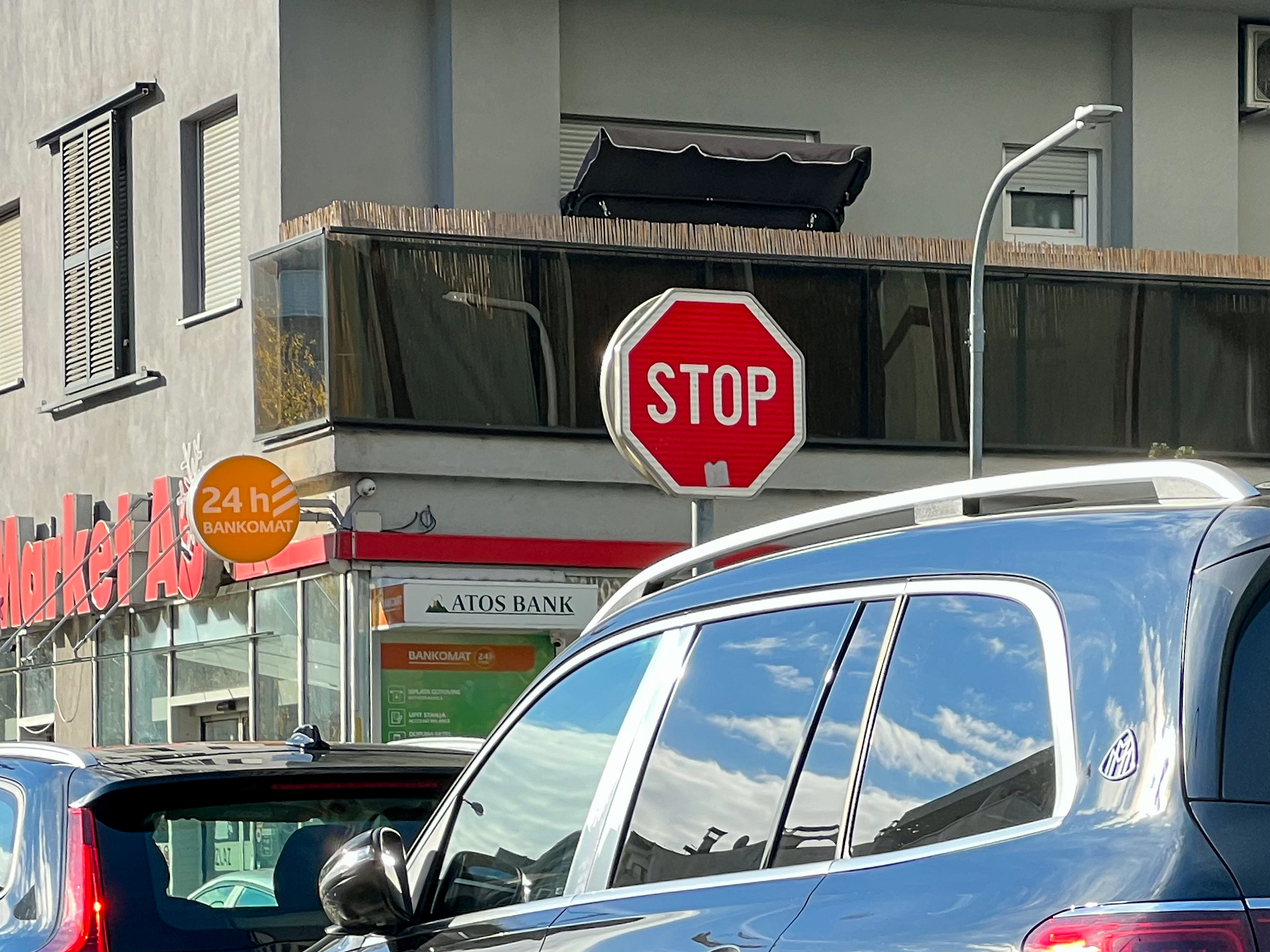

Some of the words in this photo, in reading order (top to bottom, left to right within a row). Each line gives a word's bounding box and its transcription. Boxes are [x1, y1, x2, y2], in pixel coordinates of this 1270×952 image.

[647, 362, 777, 426] STOP
[202, 487, 243, 513] 24
[250, 487, 269, 513] h
[203, 520, 293, 534] BANKOMAT
[452, 594, 506, 613] ATOS
[513, 595, 574, 613] BANK
[408, 651, 471, 662] BANKOMAT
